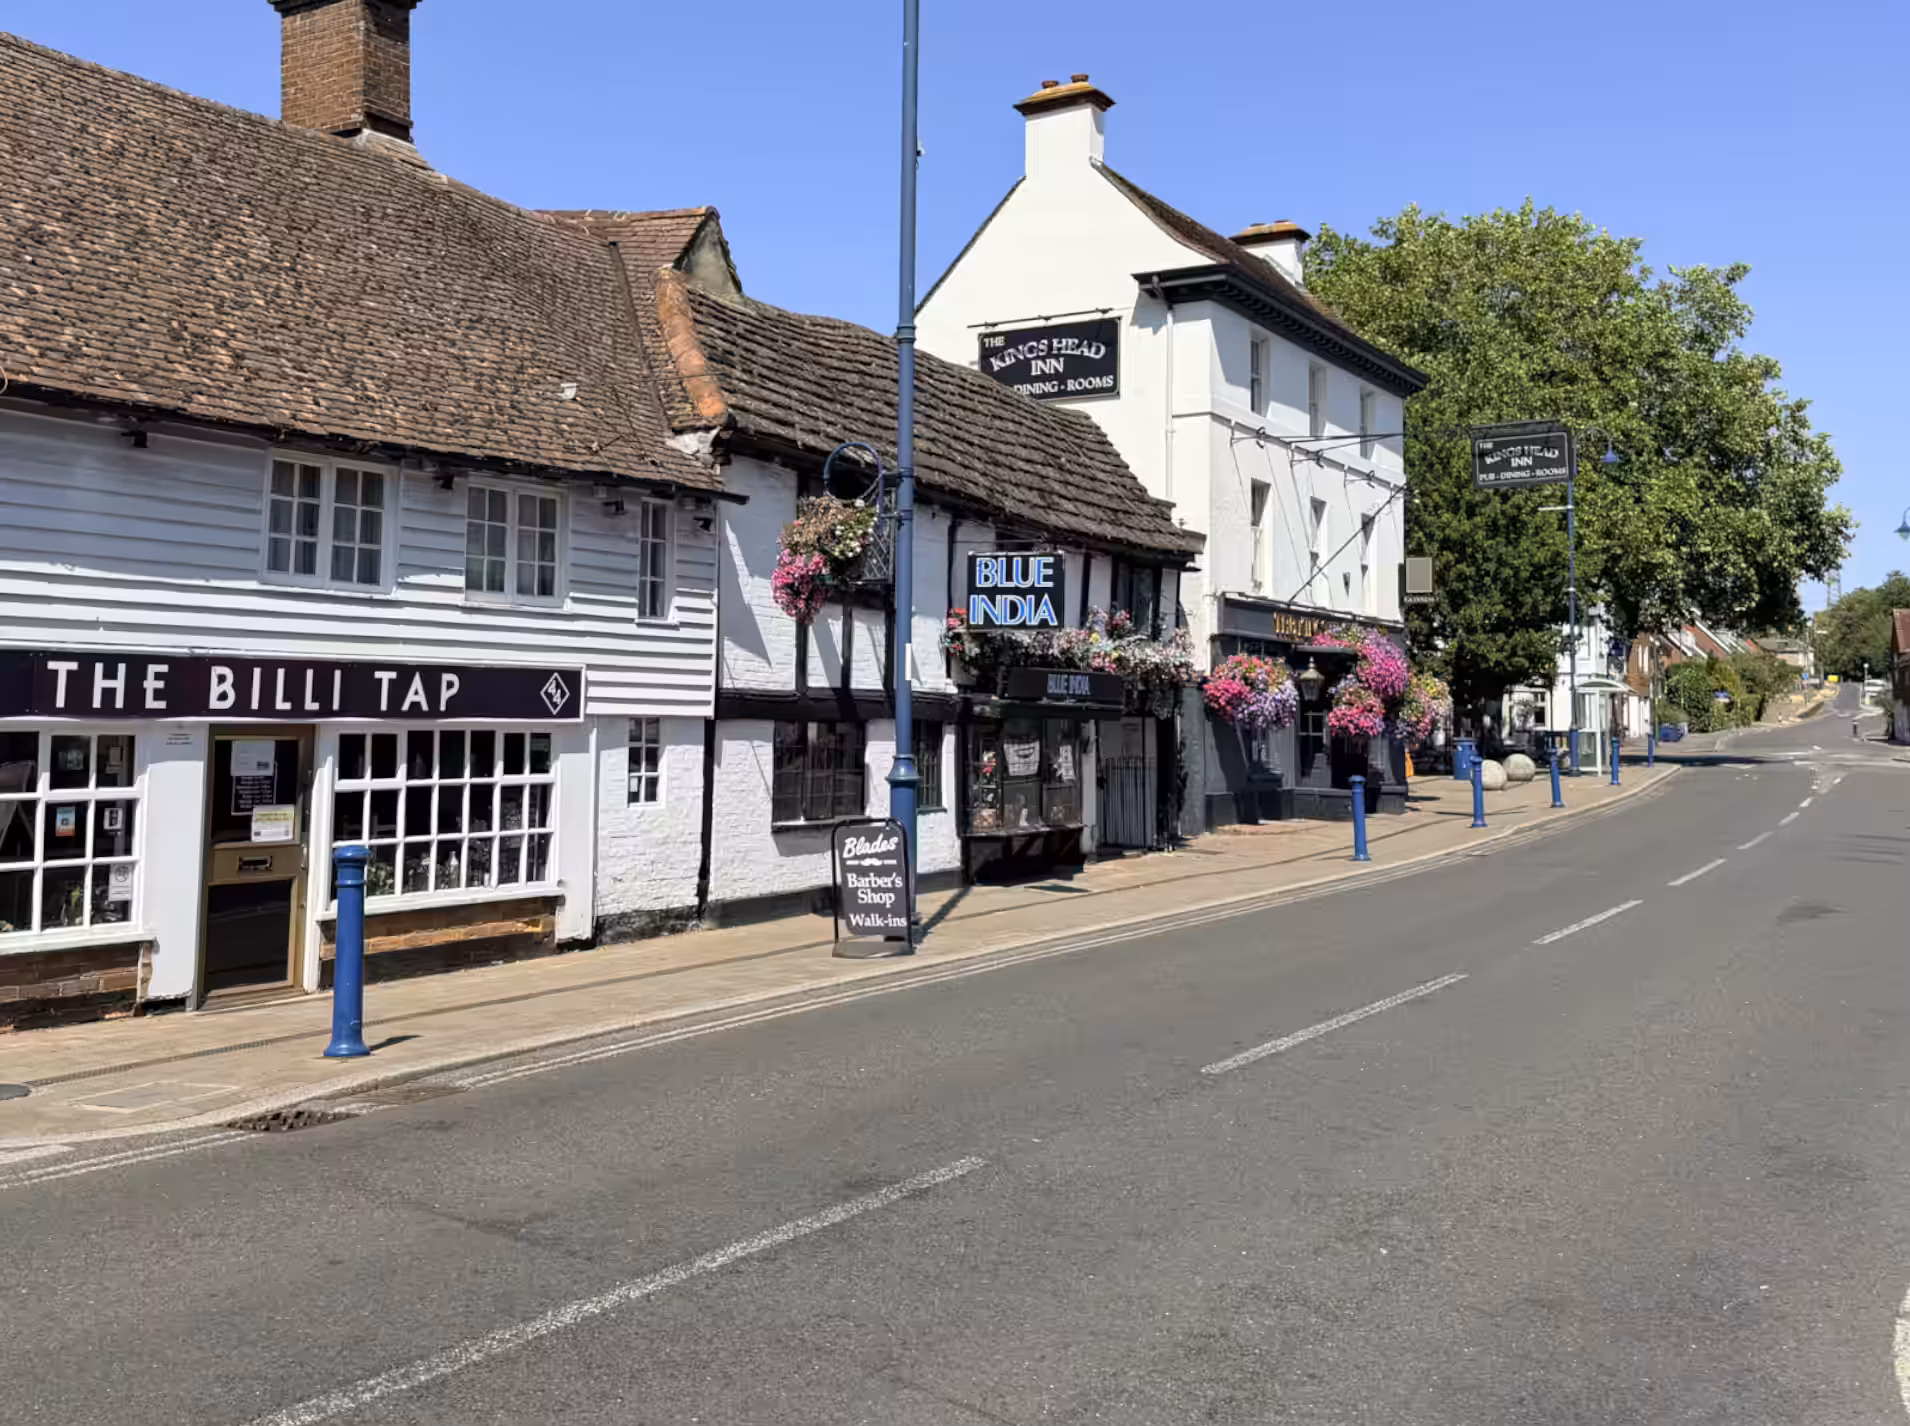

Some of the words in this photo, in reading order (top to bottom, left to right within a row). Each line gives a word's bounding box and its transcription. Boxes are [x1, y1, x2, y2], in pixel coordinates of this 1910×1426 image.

[984, 336, 1005, 348] THE
[990, 339, 1049, 371] KINGS
[1051, 338, 1106, 359] HEAD
[1030, 357, 1064, 376] INN
[1014, 381, 1059, 395] DINING
[1067, 375, 1114, 391] ROOMS
[1511, 457, 1533, 467] INN
[1535, 467, 1566, 477] ROOMS
[975, 557, 1054, 588] BLUE
[969, 593, 1058, 626] INDIA
[47, 661, 169, 709] THE
[208, 665, 341, 711] BILLI
[374, 671, 460, 711] TAP
[842, 833, 898, 858] Blades
[846, 872, 903, 888] Barber's
[857, 889, 895, 908] Shop
[849, 913, 907, 927] Walk-ins
